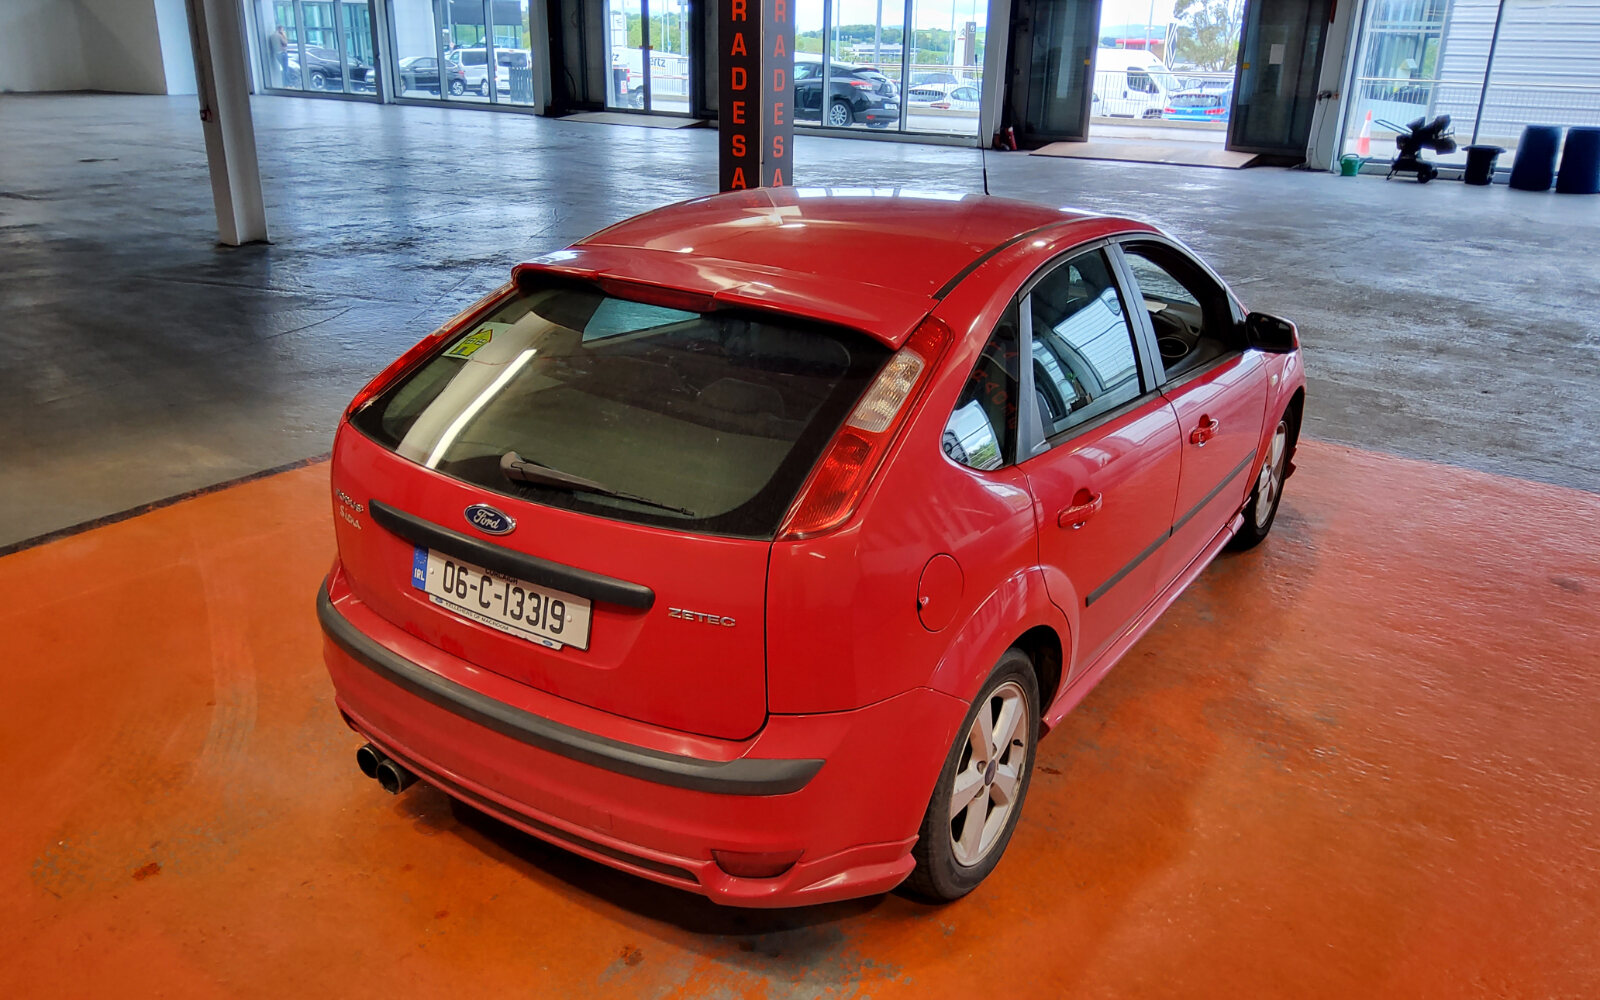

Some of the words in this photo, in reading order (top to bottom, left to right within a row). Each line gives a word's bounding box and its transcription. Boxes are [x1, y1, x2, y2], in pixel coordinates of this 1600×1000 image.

[473, 509, 501, 530] Ford
[414, 567, 425, 581] IRL
[443, 560, 566, 634] 06-C-13319
[668, 607, 736, 627] ZETEC
